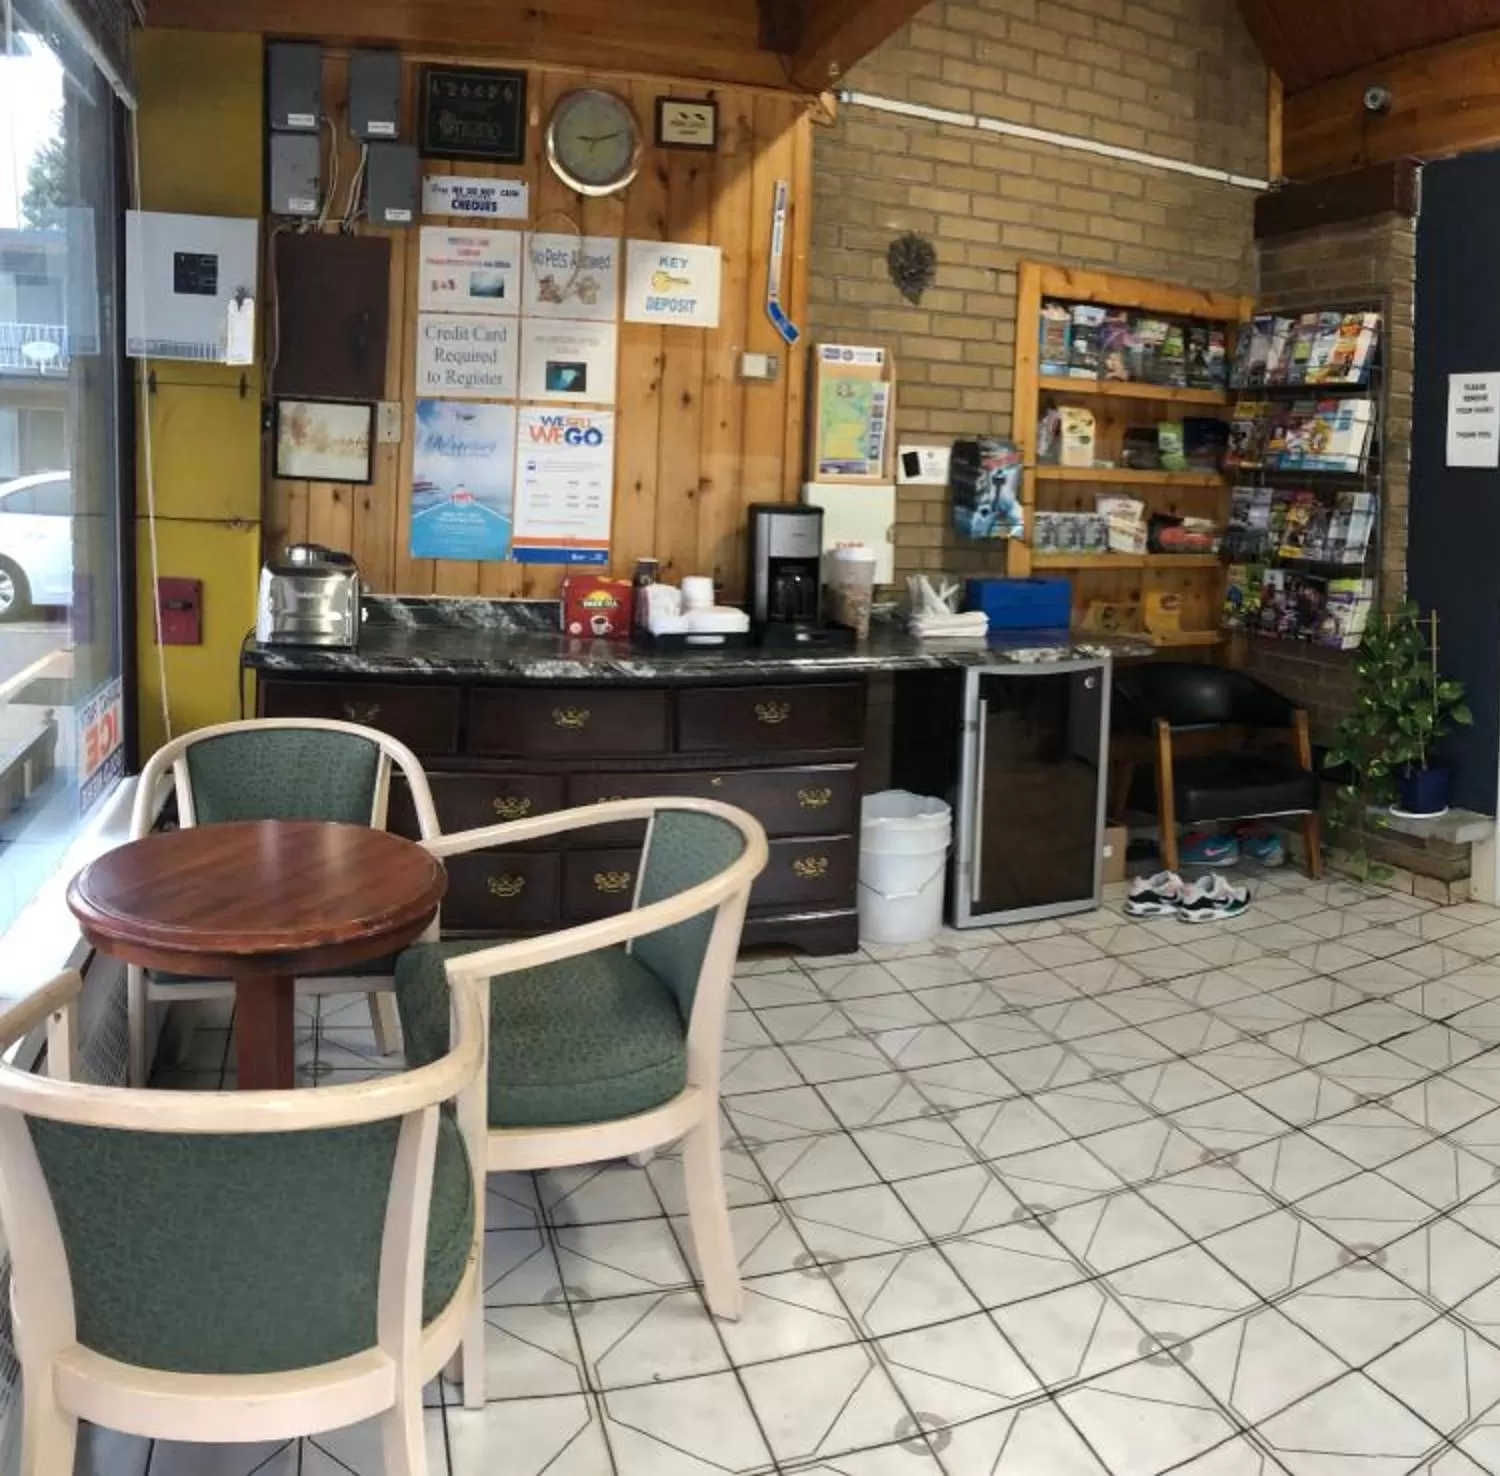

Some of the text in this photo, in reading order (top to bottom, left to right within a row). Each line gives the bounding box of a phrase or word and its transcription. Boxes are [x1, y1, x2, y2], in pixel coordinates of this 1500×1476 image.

[451, 199, 497, 212] CHEQUES
[546, 248, 569, 269] Pets
[659, 254, 689, 269] KEY
[645, 296, 698, 314] DEPOSIT
[425, 325, 507, 343] Credit Card
[434, 347, 498, 366] Required
[427, 368, 503, 388] to Register
